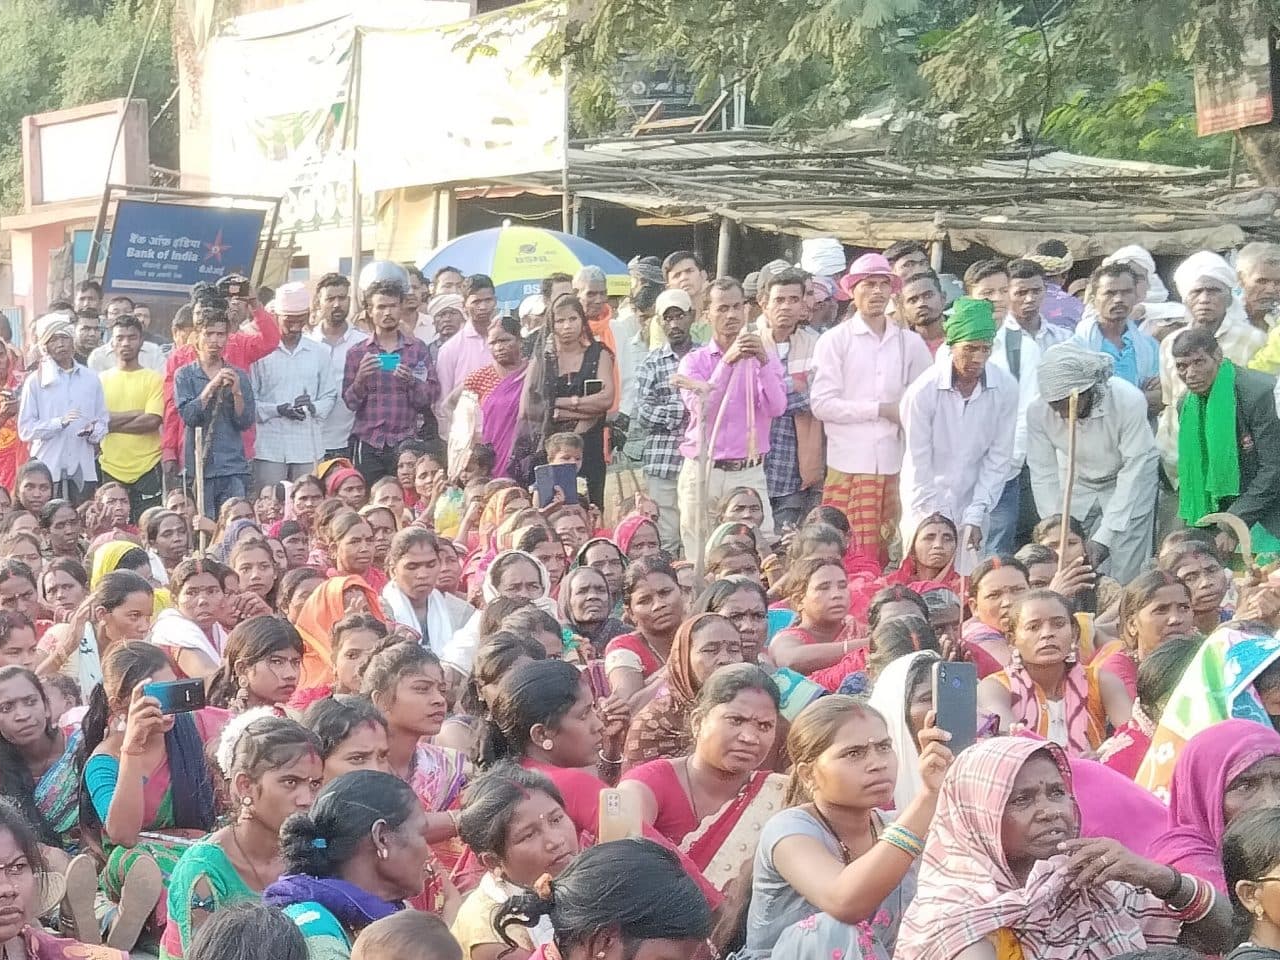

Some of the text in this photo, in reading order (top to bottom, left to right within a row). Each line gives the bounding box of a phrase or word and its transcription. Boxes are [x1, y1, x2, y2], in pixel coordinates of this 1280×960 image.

[126, 247, 199, 262] Bank of India
